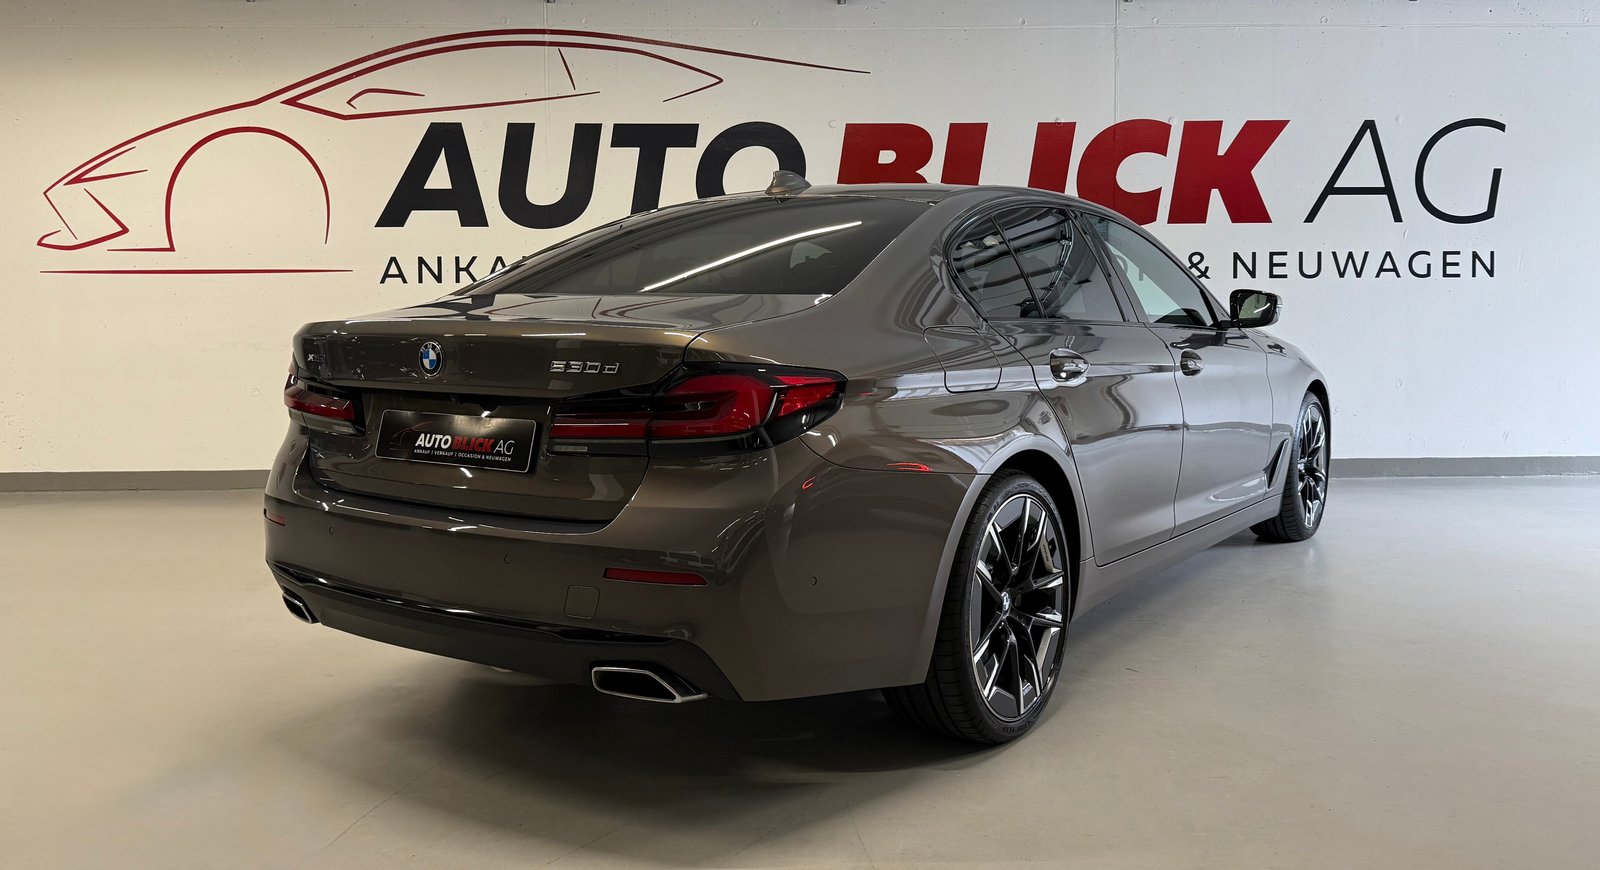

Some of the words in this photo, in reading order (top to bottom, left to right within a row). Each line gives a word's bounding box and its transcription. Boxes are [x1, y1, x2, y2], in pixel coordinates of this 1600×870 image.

[374, 121, 806, 229] AUTO
[1303, 118, 1506, 224] AG
[1187, 251, 1211, 279] &
[1233, 250, 1496, 279] NEUWAGEN
[415, 433, 452, 449] AUTO
[452, 436, 495, 454] BLICK
[493, 439, 515, 455] AG
